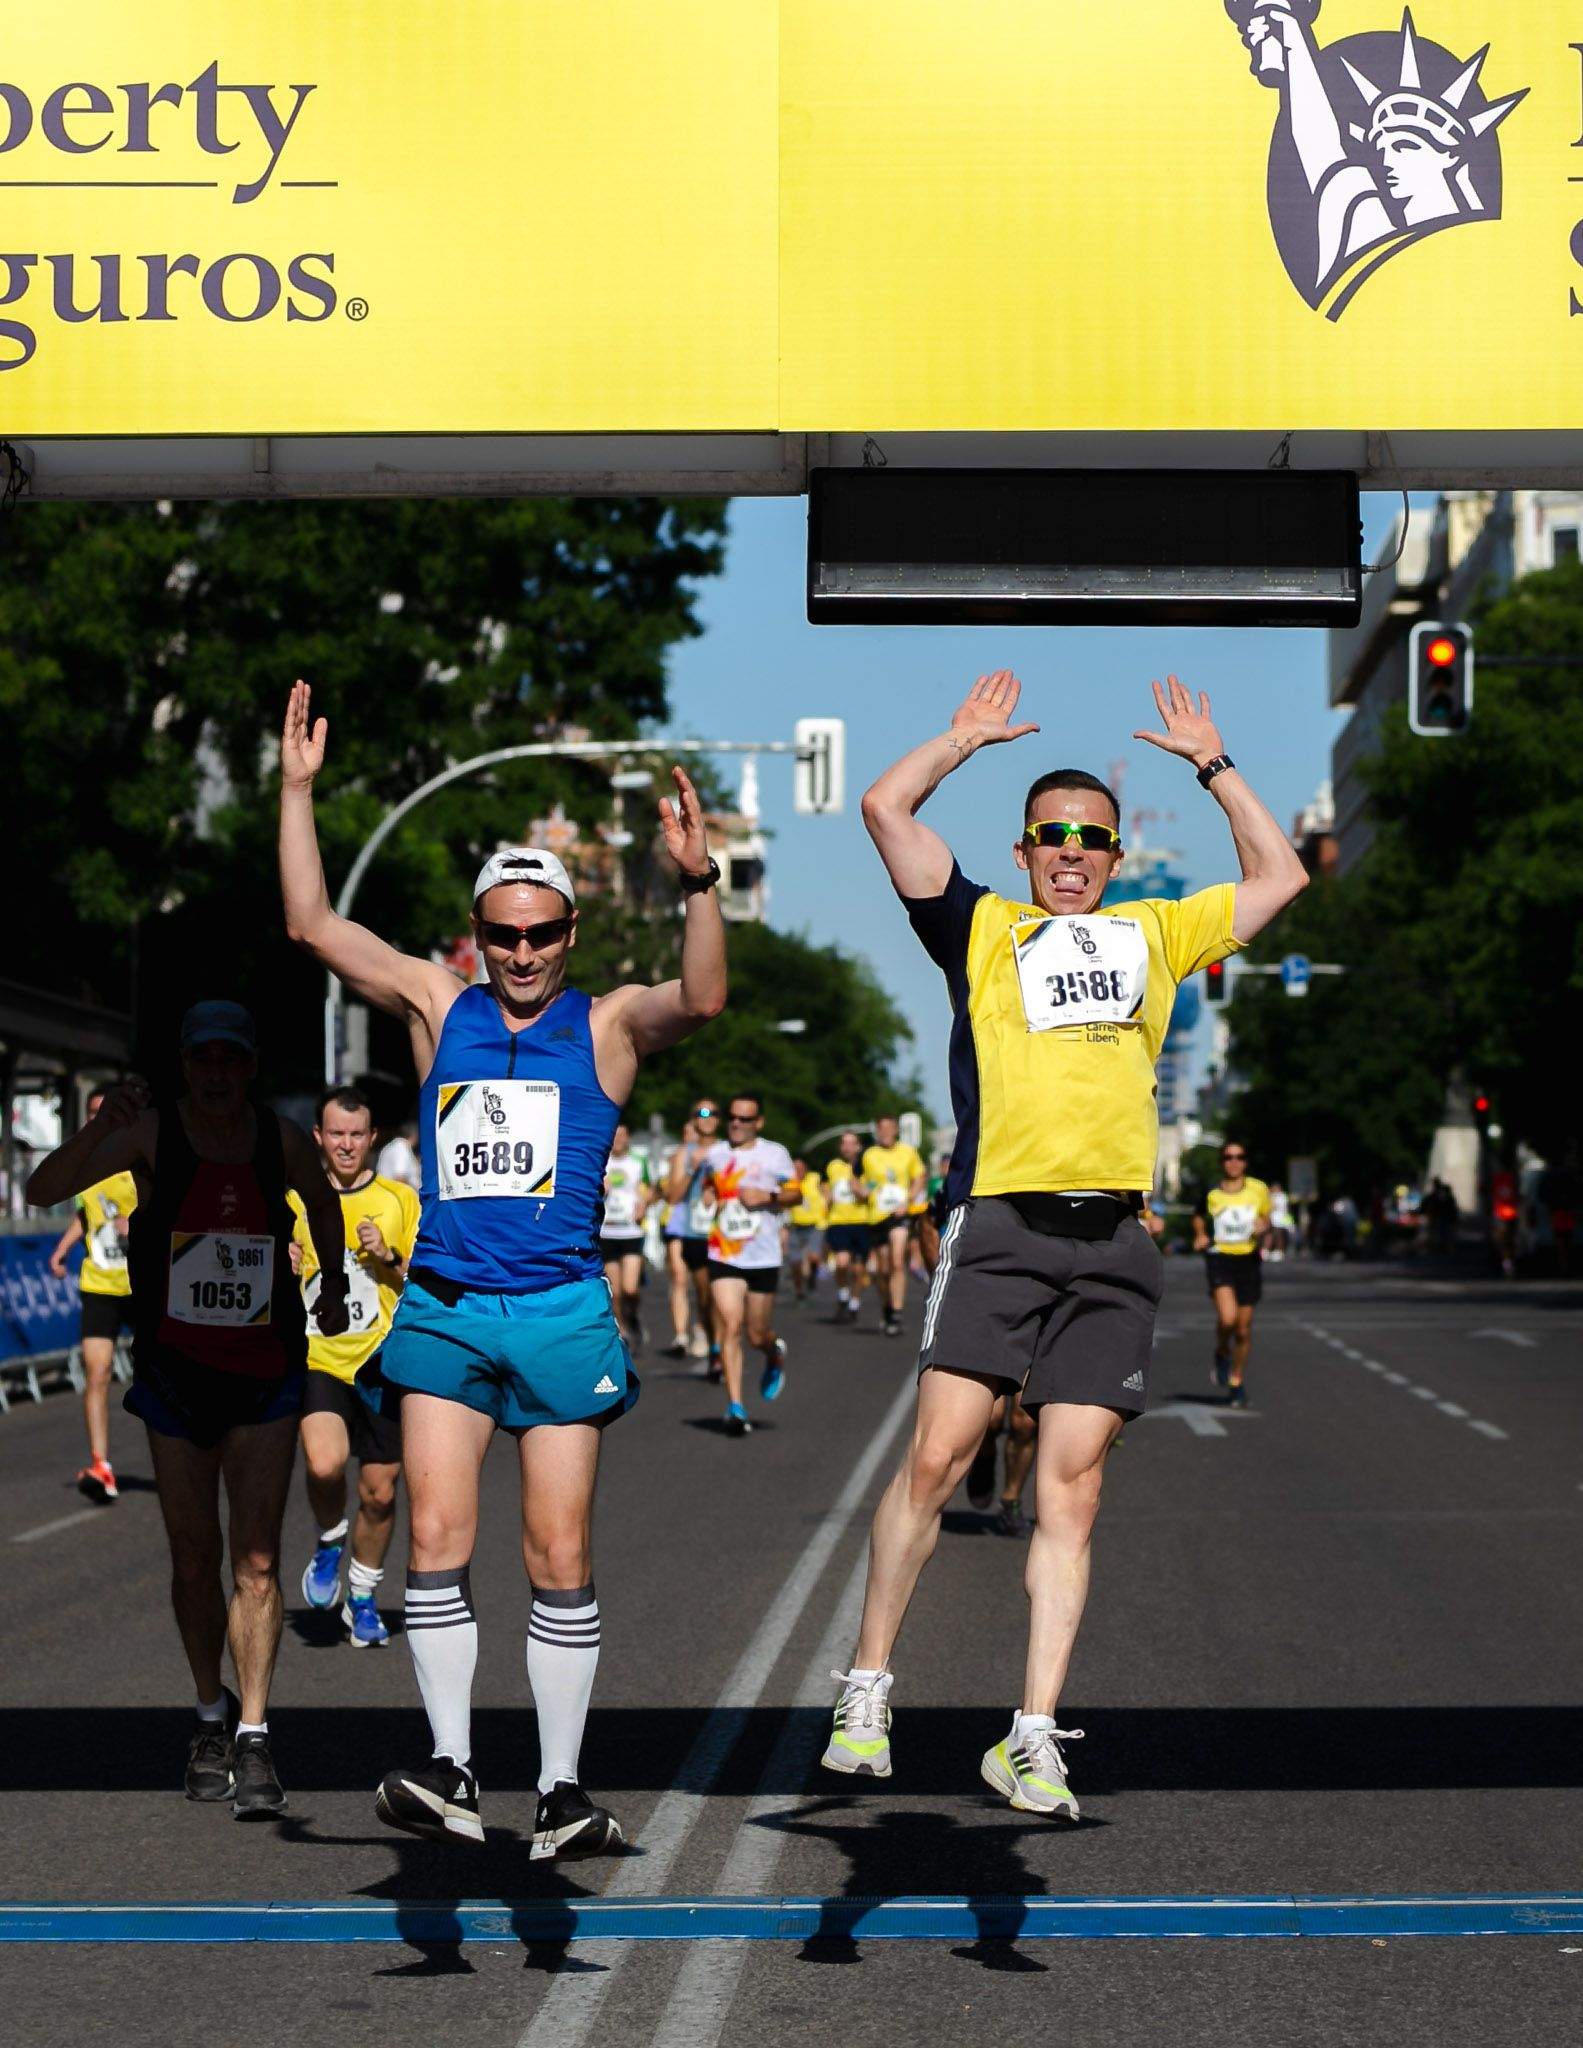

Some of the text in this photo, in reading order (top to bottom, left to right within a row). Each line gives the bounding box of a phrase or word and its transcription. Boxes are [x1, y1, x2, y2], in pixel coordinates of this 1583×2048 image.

[1086, 1033, 1120, 1046] Liberty
[454, 1141, 534, 1177] 3589
[237, 1247, 264, 1268] 9861
[189, 1280, 252, 1311] 1053
